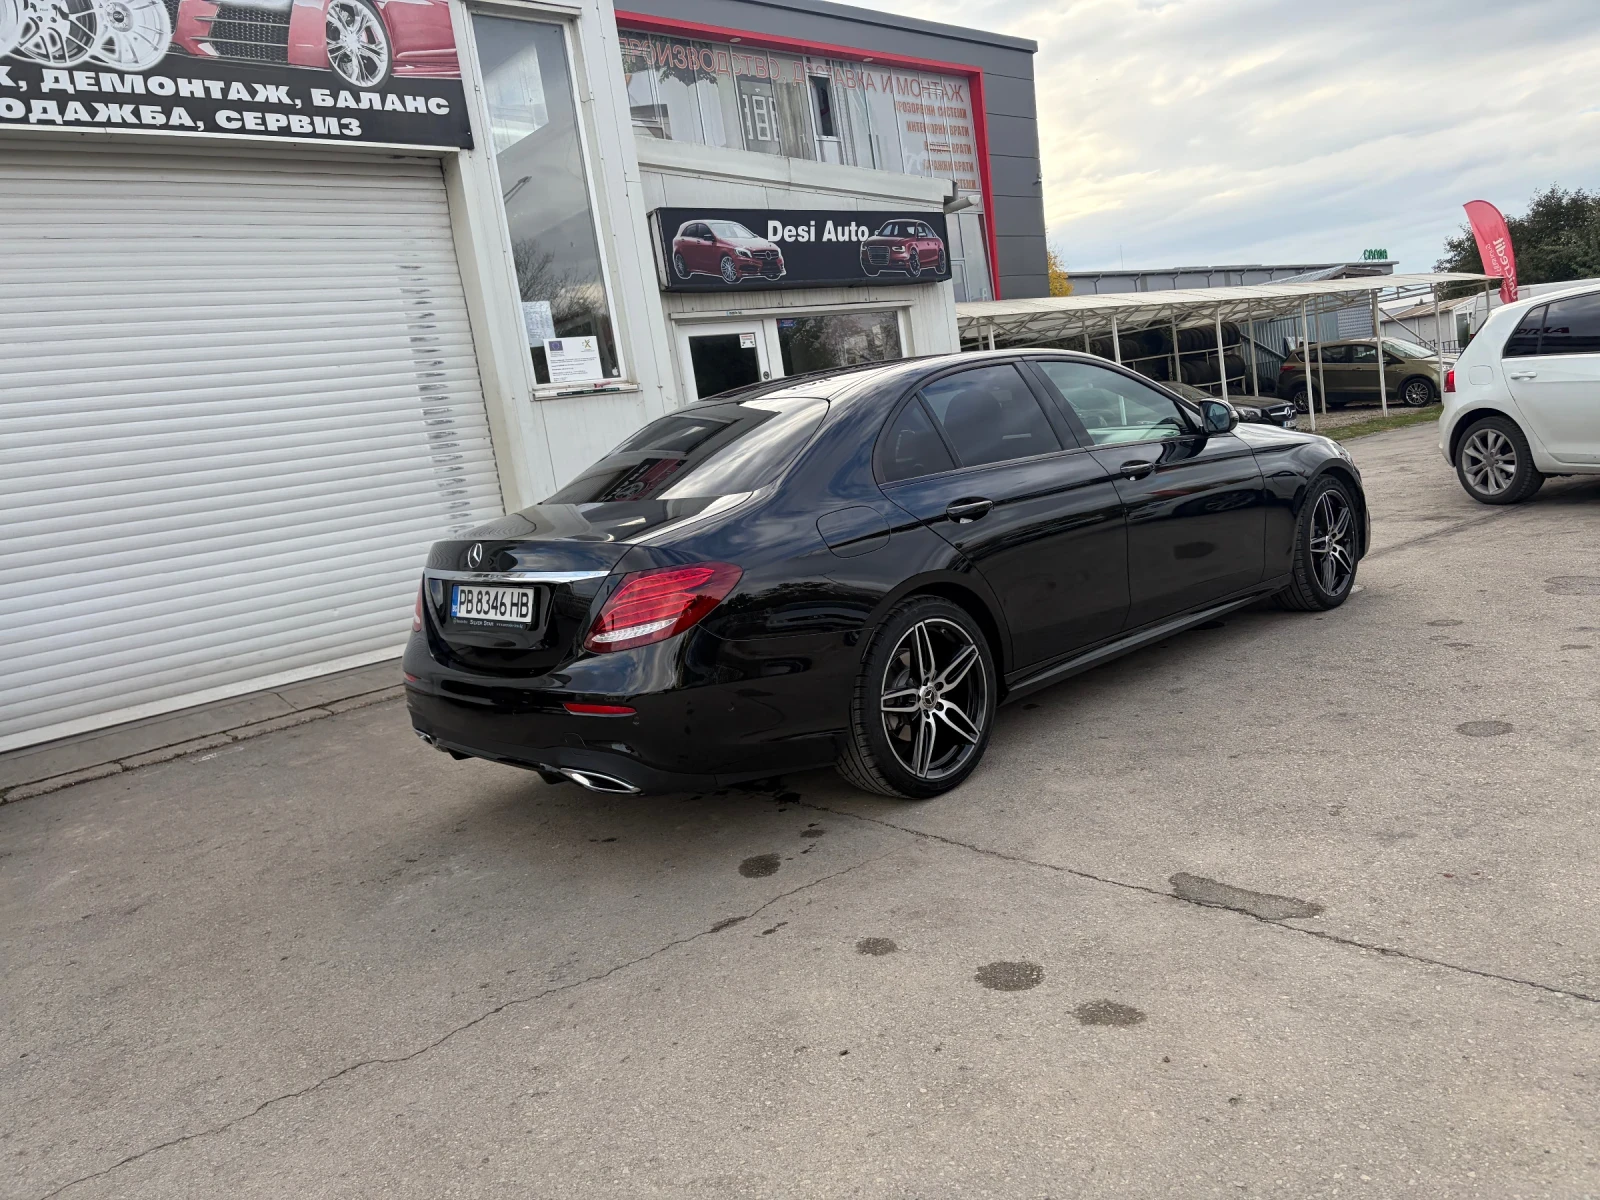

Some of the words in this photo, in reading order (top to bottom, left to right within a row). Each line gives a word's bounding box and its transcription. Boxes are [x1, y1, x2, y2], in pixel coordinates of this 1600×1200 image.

[40, 68, 302, 109] ДЕМОНТАЖ,
[310, 88, 450, 115] БАЛАНС
[215, 109, 362, 136] СЕРВИЗ
[767, 220, 815, 242] Desi
[822, 220, 869, 242] Auto
[459, 589, 474, 614] PB
[476, 590, 507, 616] 8346
[510, 591, 529, 618] HB
